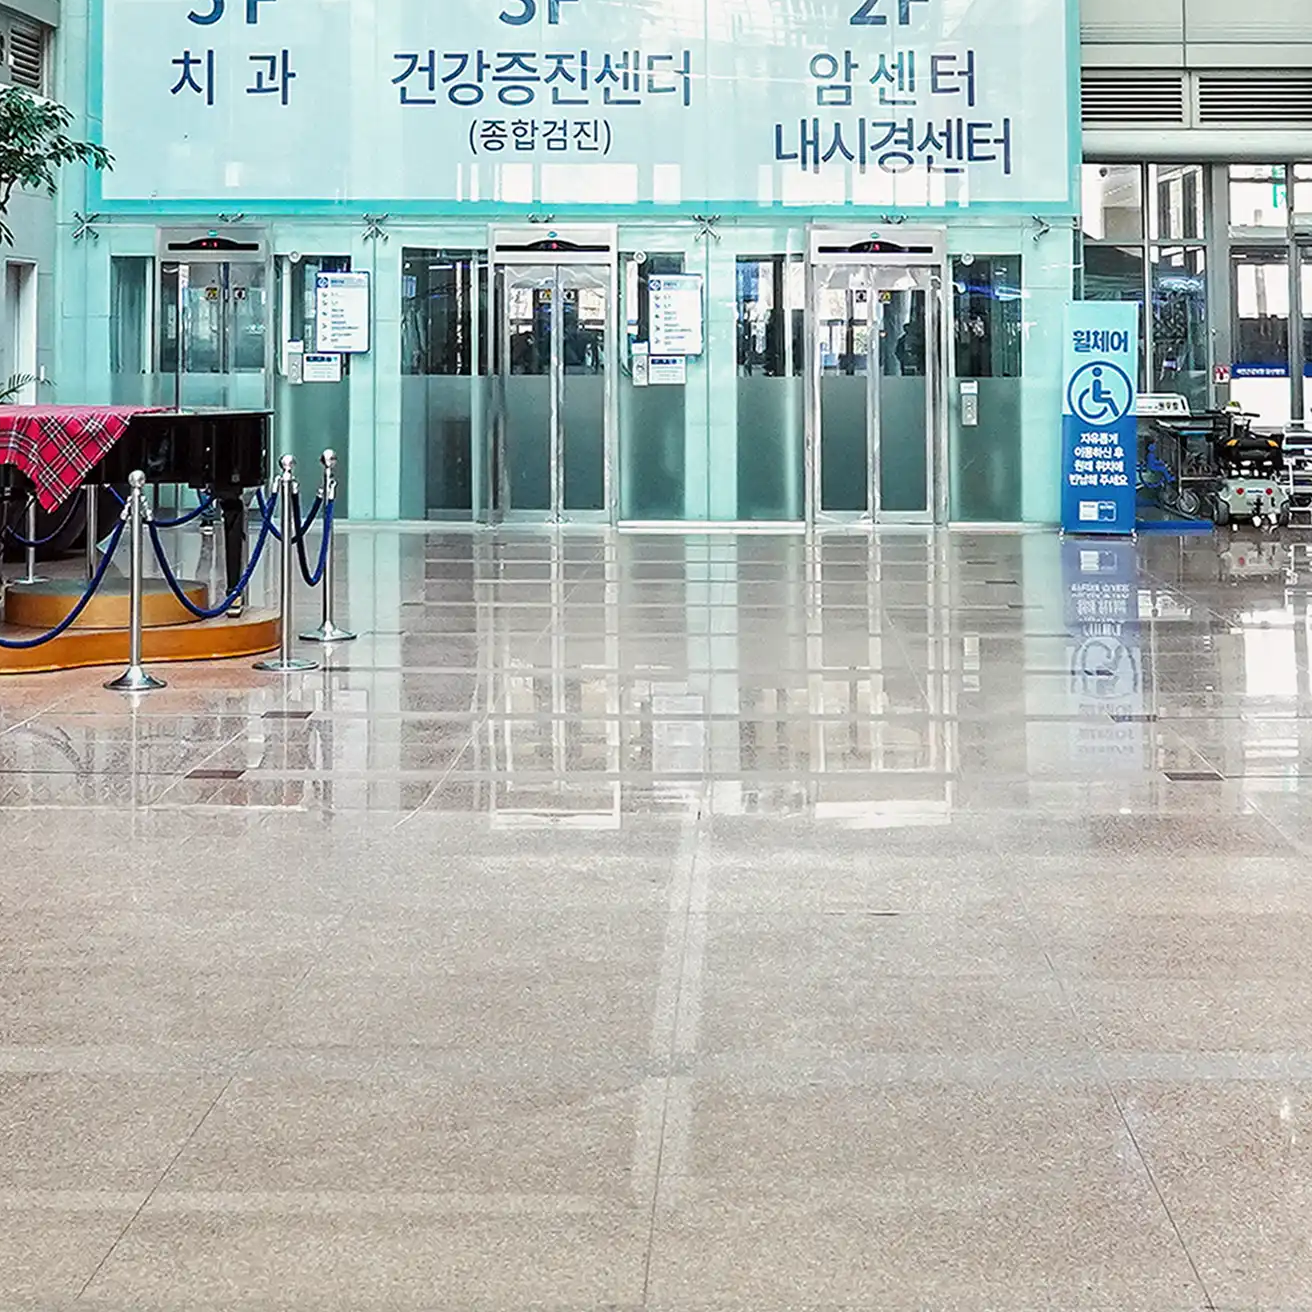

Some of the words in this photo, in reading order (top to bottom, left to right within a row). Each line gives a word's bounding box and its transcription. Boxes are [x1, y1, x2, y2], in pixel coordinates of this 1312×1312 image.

[391, 49, 692, 108] 건강증진센터
[810, 50, 976, 108] 암센터
[468, 119, 612, 156] (종합검진)
[774, 117, 1013, 175] 내시경센터
[1073, 330, 1128, 353] 휠체어
